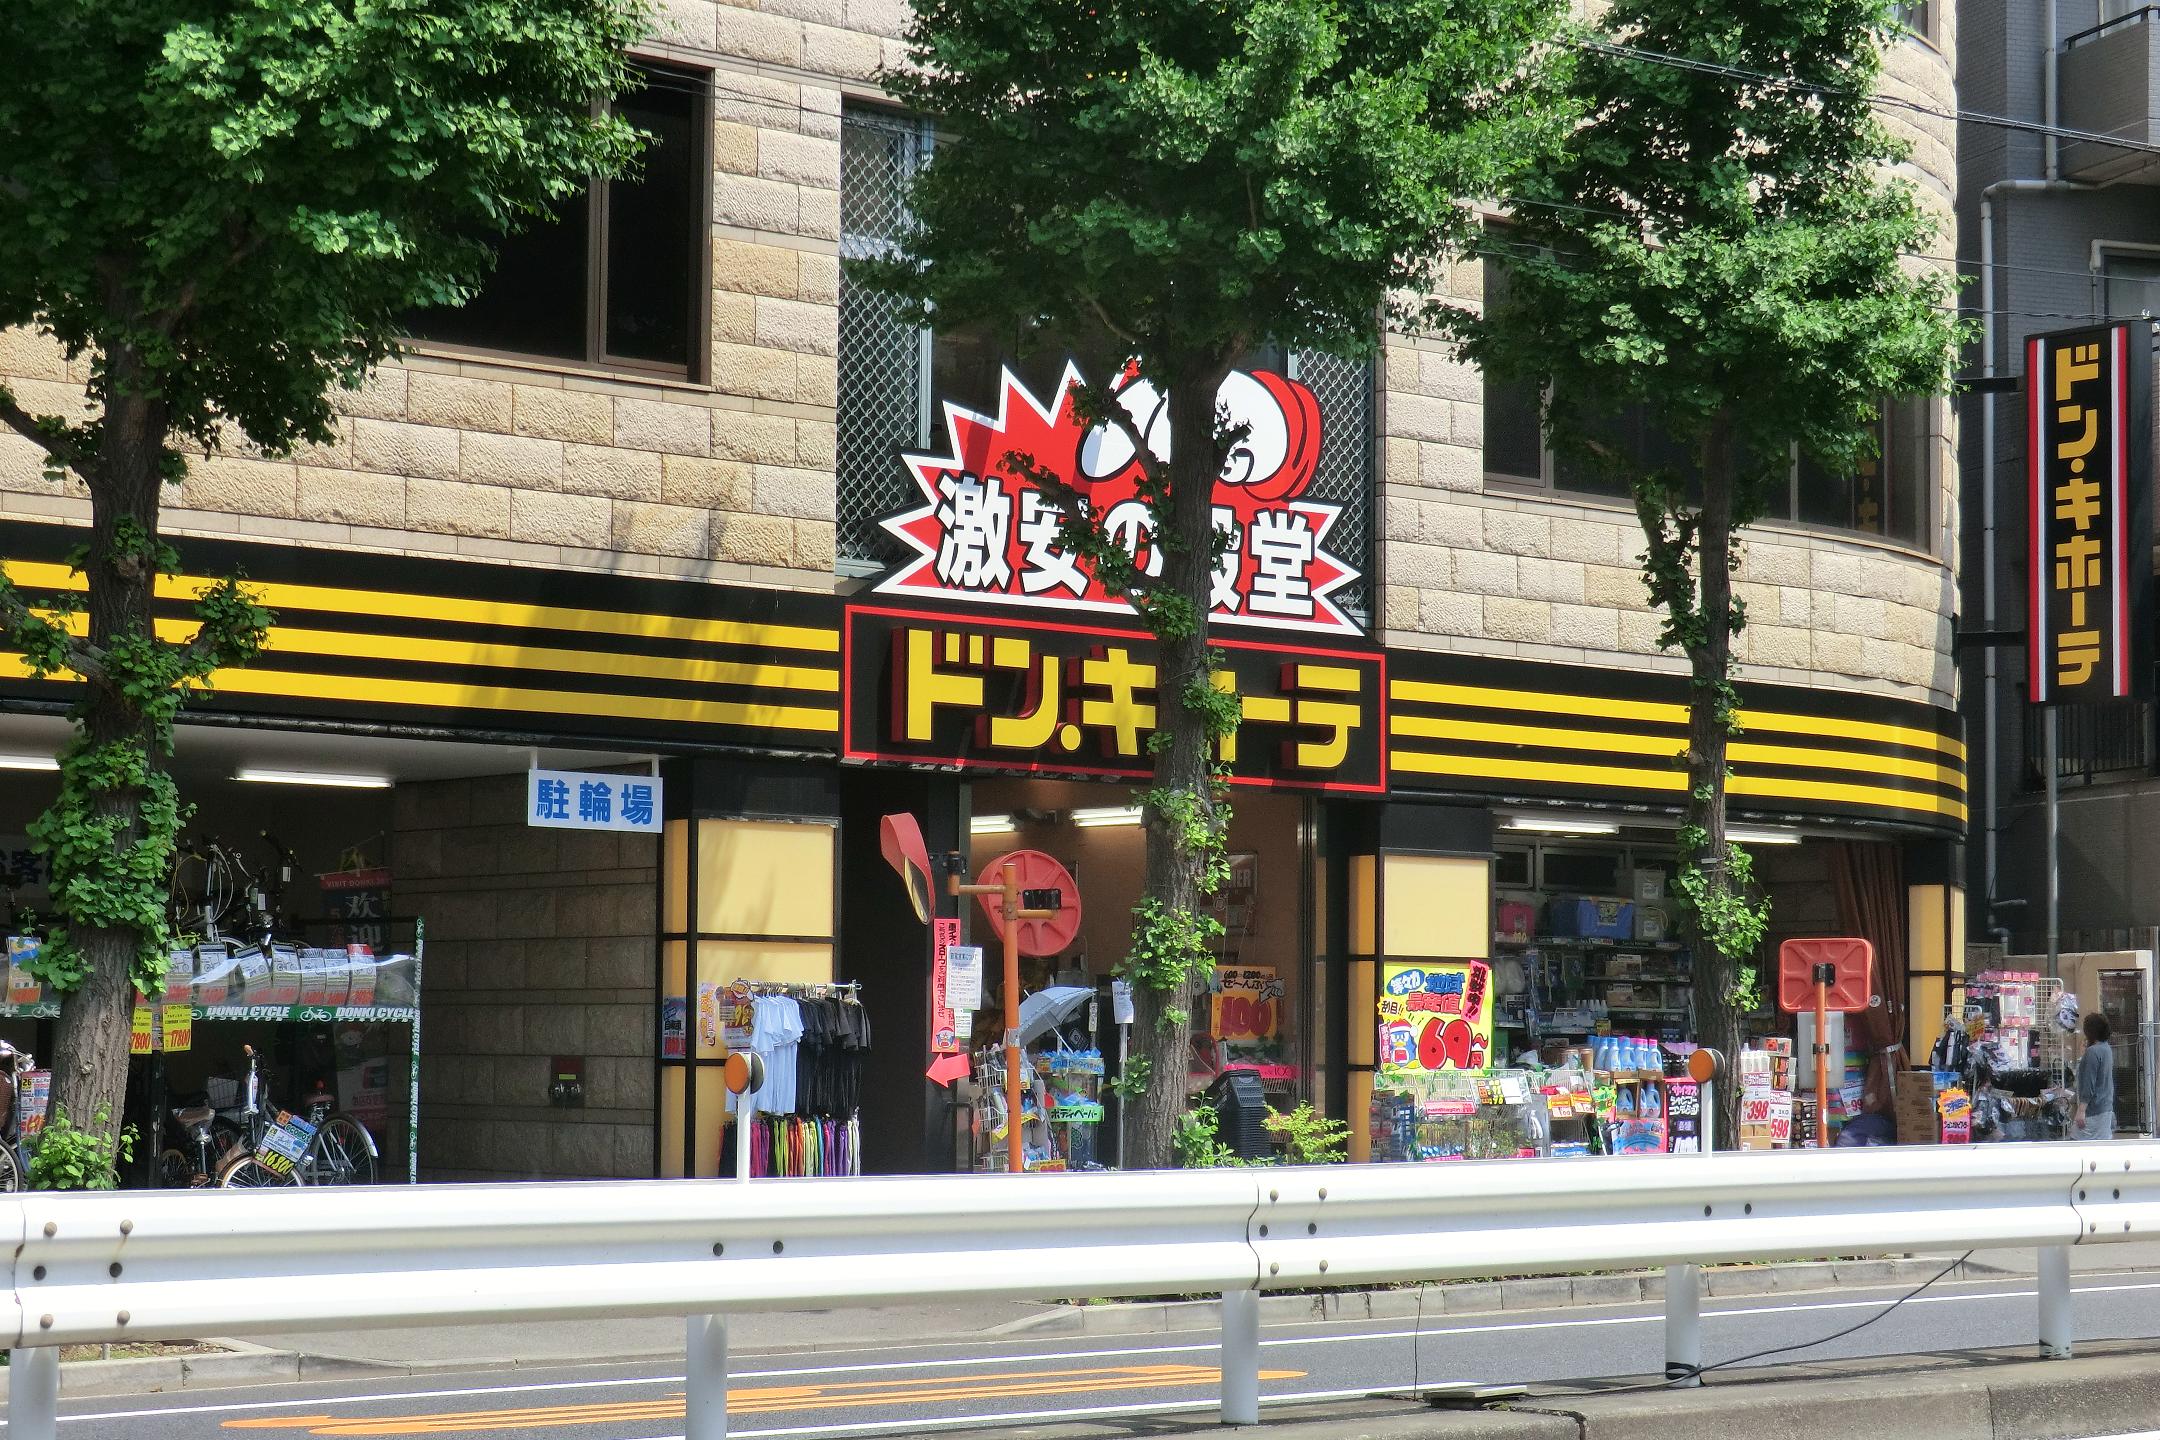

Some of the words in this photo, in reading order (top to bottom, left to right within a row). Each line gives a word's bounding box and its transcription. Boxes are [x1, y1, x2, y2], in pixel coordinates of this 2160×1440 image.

[2055, 343, 2101, 686] ドン・キホーテ
[907, 628, 1362, 768] ドン・キーテ
[536, 778, 655, 825] 駐輪場
[206, 1006, 248, 1018] DONKI
[249, 1006, 290, 1018] CYCLE
[335, 1007, 378, 1018] DONKI
[1406, 990, 1462, 1016] 最安値
[1050, 1107, 1098, 1120] ボディペーパー
[1747, 1100, 1770, 1120] 398
[1770, 1118, 1790, 1139] 598
